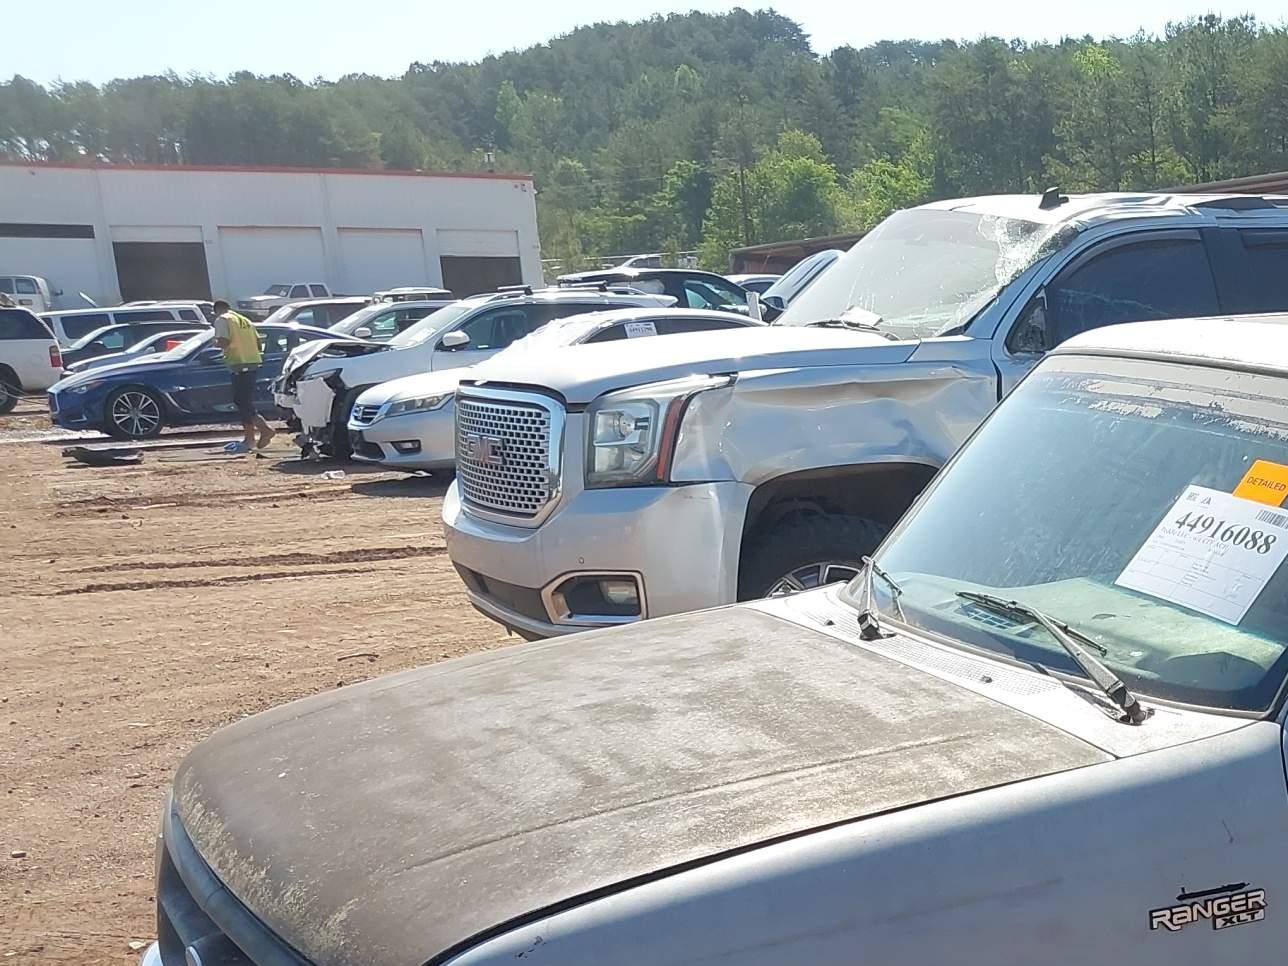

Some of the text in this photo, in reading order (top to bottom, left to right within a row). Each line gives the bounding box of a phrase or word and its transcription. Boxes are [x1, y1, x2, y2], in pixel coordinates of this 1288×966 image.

[466, 435, 504, 464] GMC
[1246, 476, 1287, 493] DETAILED
[1175, 511, 1278, 555] 44916088
[1149, 888, 1268, 931] RANGER
[1221, 910, 1260, 927] XLT
